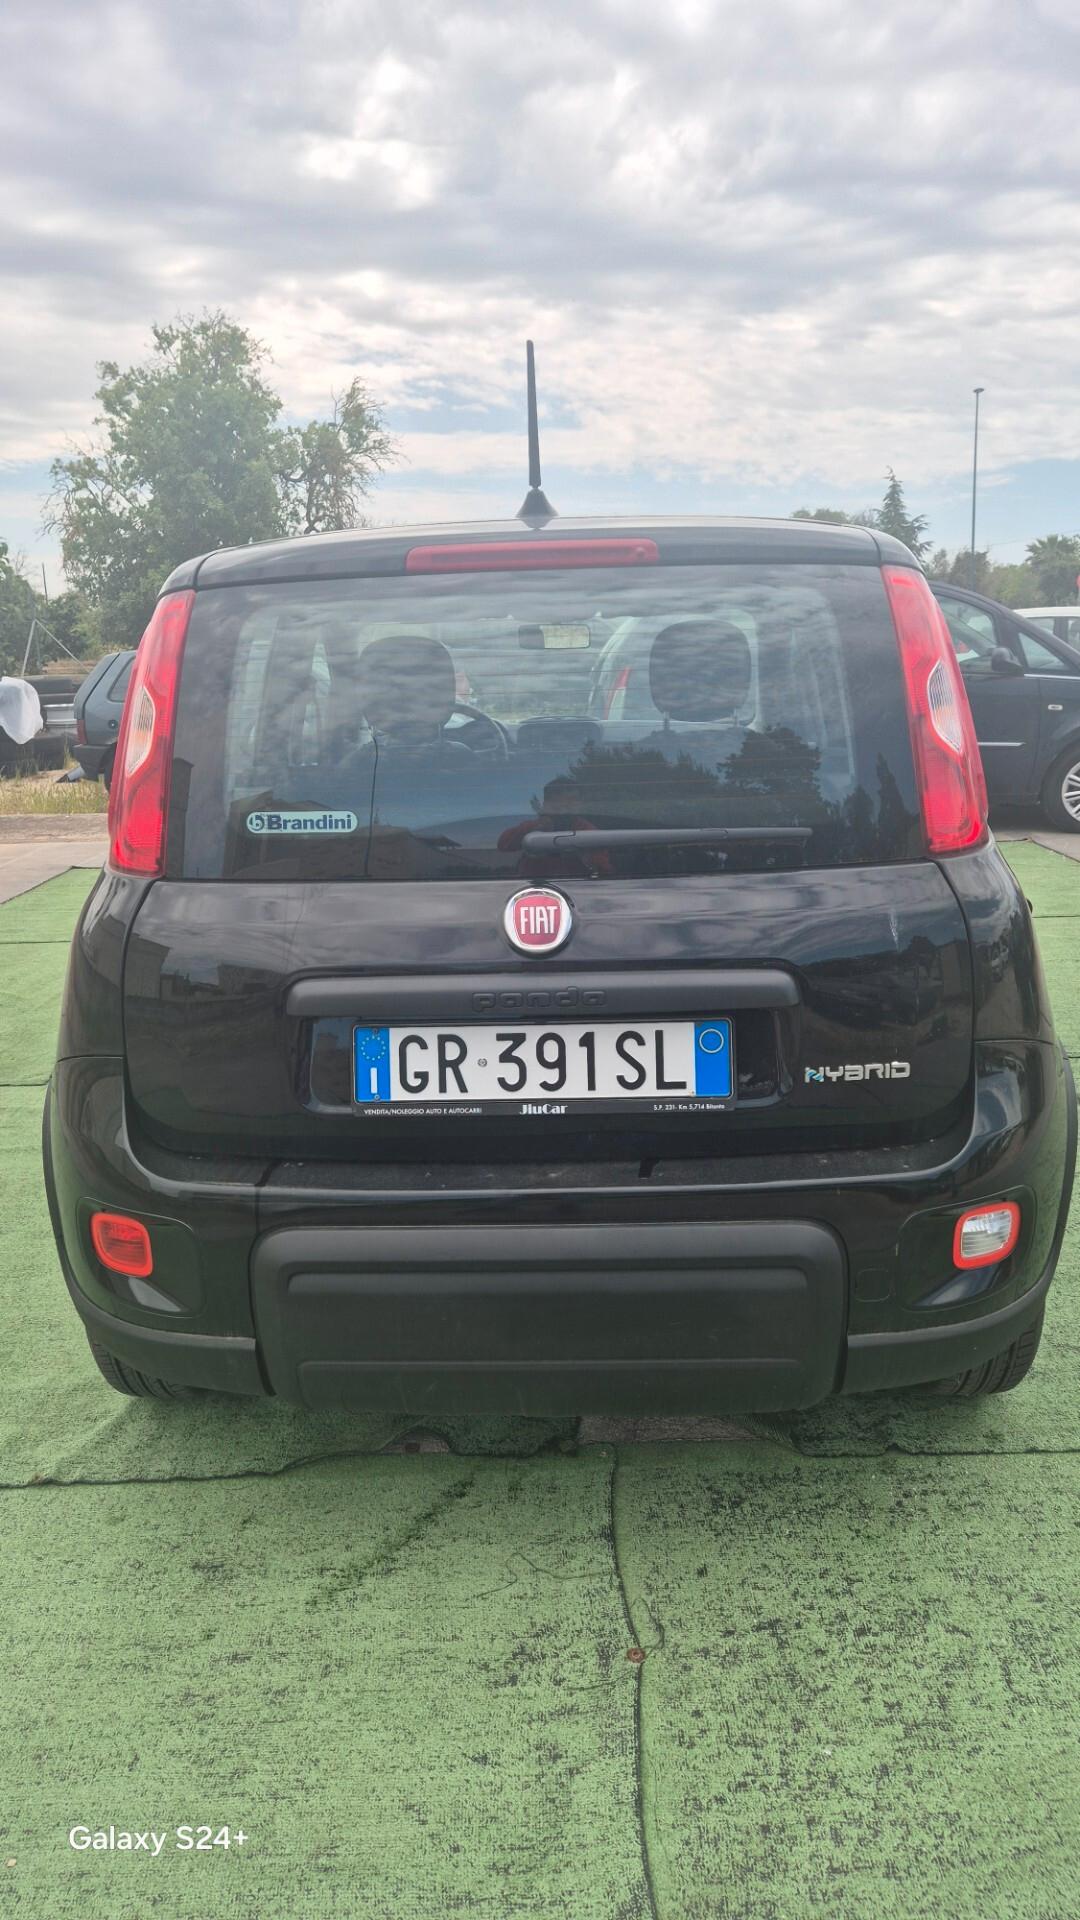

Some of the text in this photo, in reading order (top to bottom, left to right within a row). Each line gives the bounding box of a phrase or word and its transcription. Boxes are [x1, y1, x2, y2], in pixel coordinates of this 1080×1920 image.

[267, 813, 352, 830] Brandini
[520, 905, 558, 935] FIAT
[471, 985, 606, 1013] panda
[398, 1034, 469, 1094] GR
[804, 1061, 911, 1083] HYBRID
[370, 1067, 378, 1094] I
